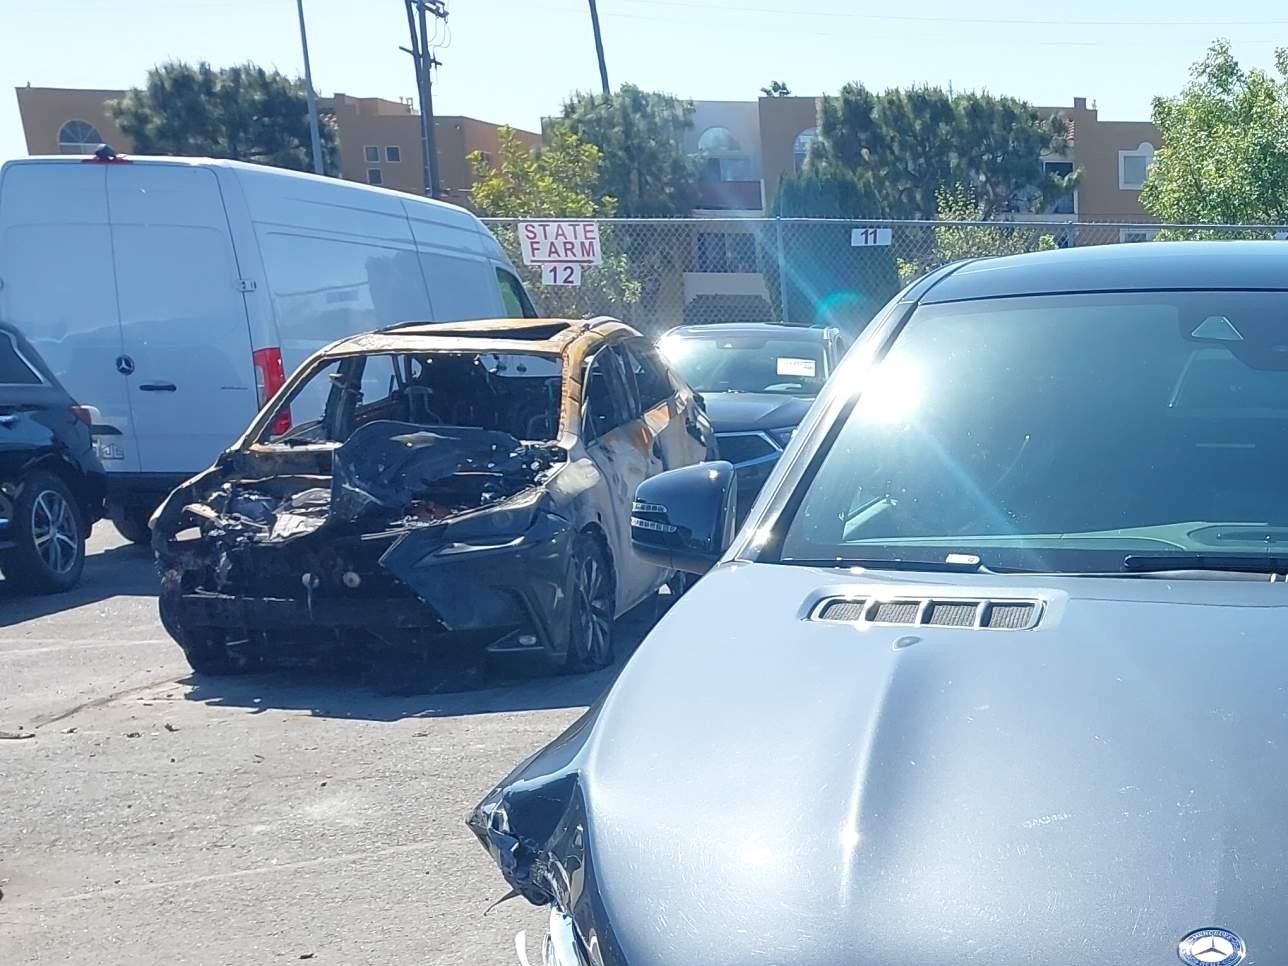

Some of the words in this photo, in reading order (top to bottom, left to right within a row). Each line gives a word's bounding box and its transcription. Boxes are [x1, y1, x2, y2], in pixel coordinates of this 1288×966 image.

[524, 223, 596, 241] STATE
[861, 229, 878, 244] 11
[529, 241, 596, 258] FARM
[549, 266, 574, 284] 12
